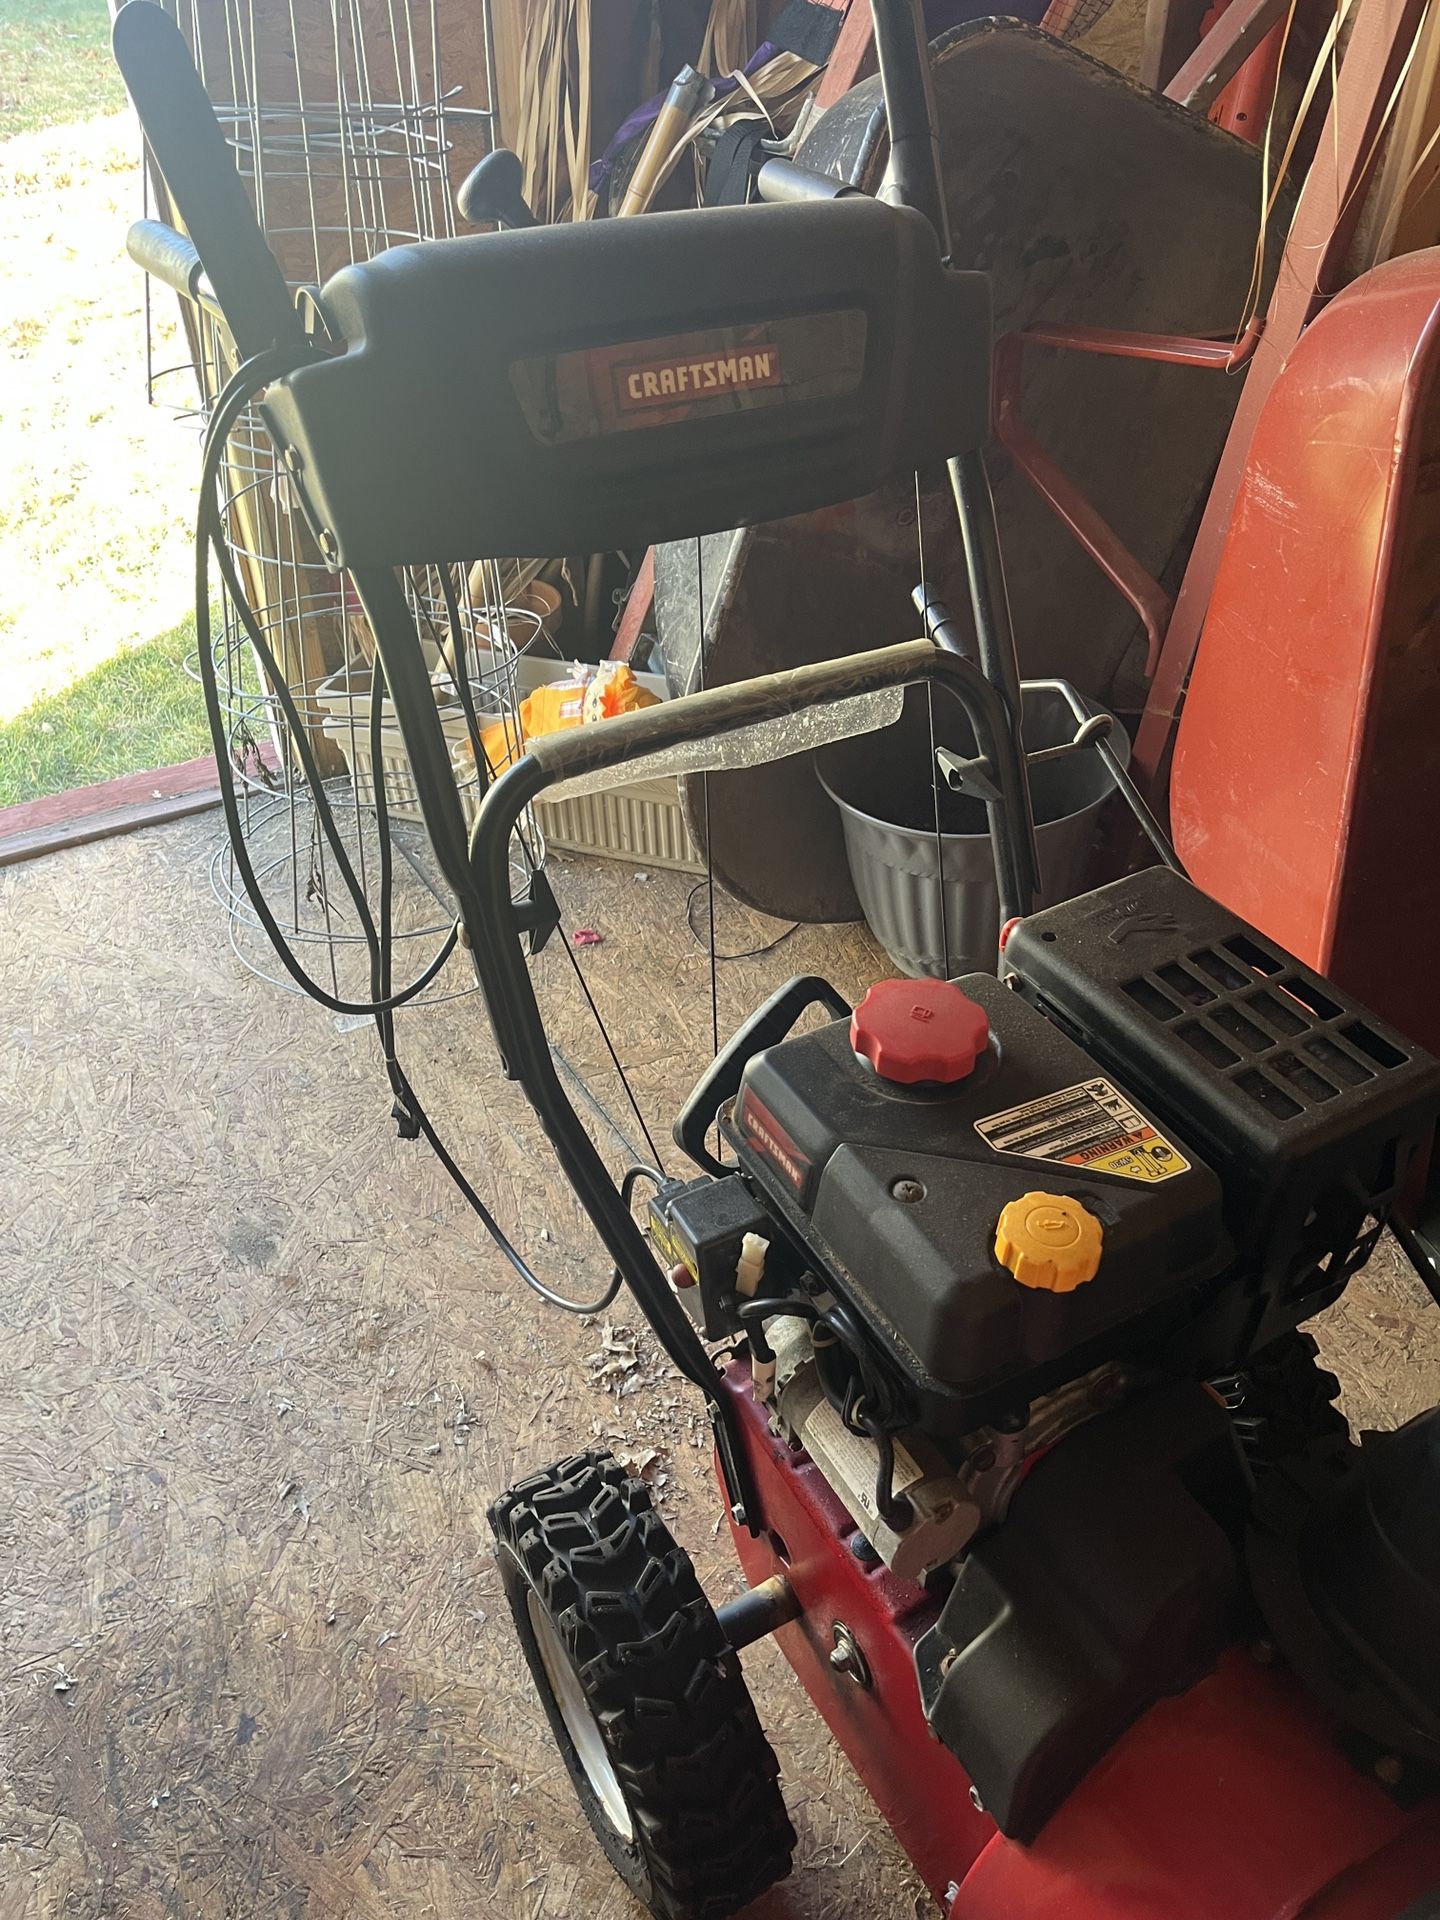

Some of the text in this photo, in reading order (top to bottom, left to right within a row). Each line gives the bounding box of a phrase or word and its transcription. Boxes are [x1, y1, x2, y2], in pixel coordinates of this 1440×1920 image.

[628, 353, 770, 399] CRAFTSMAN
[747, 1113, 800, 1181] CRAFTSMAN
[1080, 1135, 1135, 1160] WARNING
